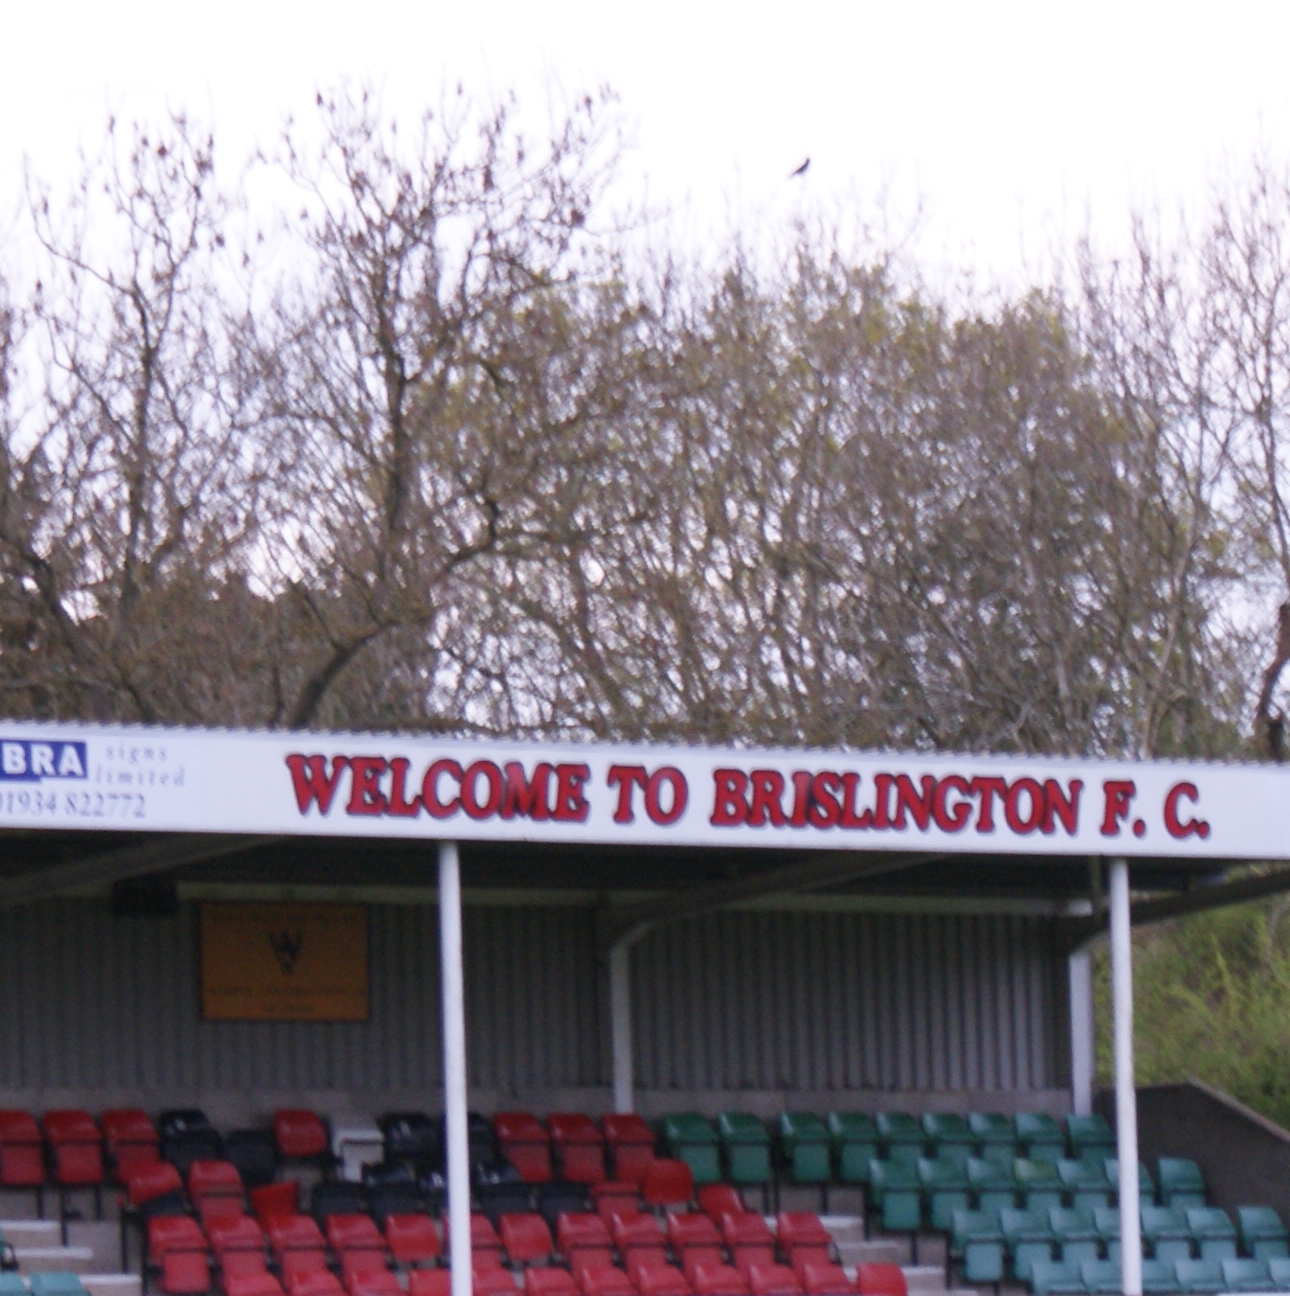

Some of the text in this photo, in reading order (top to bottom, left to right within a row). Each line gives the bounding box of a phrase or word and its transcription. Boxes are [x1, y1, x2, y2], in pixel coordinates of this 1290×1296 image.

[95, 765, 186, 787] limited
[64, 792, 146, 818] 822772
[285, 754, 590, 822] WELCOME
[607, 764, 688, 826] TO
[709, 768, 1083, 834] BRISLINGTON
